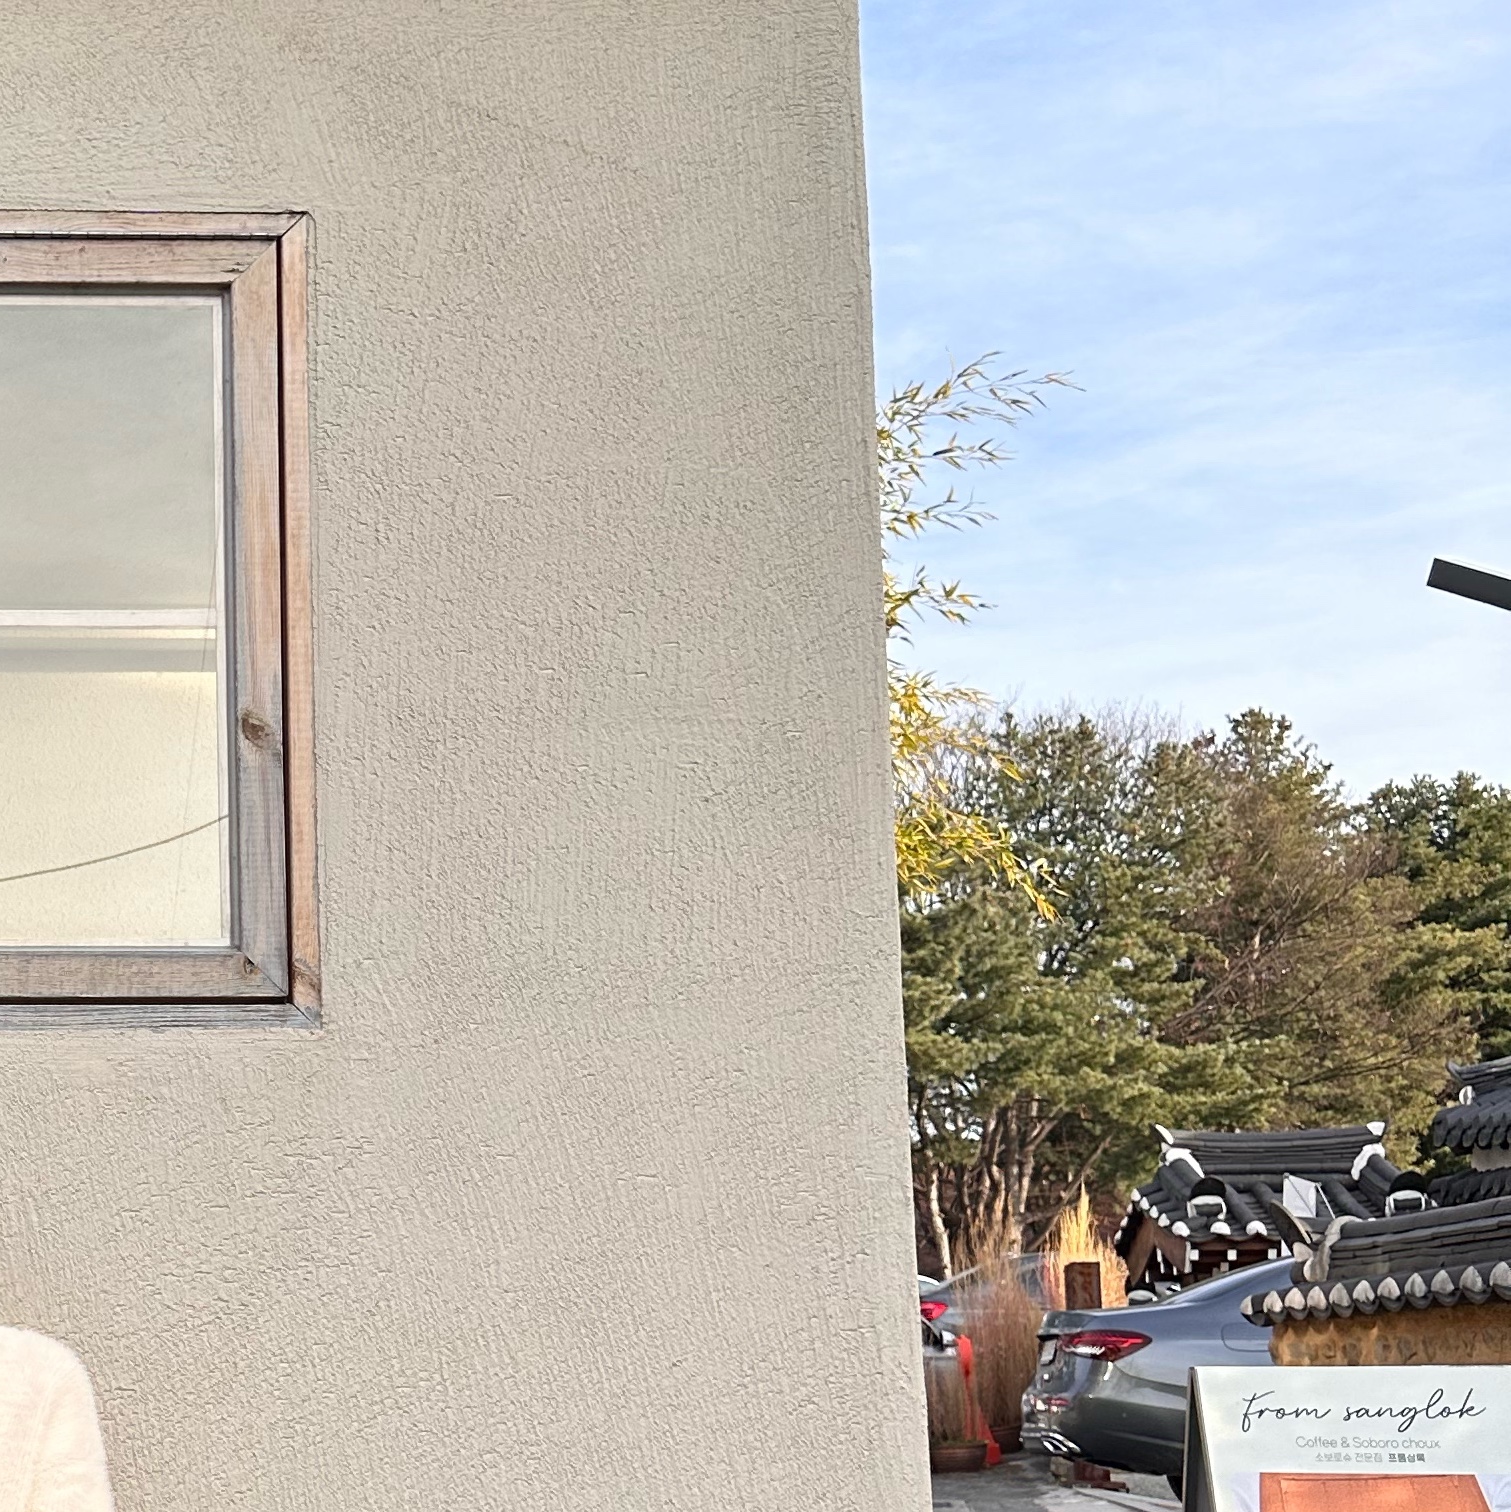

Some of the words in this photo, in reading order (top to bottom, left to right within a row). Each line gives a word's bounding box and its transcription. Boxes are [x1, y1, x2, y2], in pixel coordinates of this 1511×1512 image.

[1241, 1390, 1331, 1432] from
[1342, 1387, 1487, 1432] sanglok
[1295, 1436, 1338, 1448] Coffee
[1340, 1436, 1350, 1448] &
[1352, 1436, 1399, 1449] Soboro
[1401, 1437, 1441, 1449] choux
